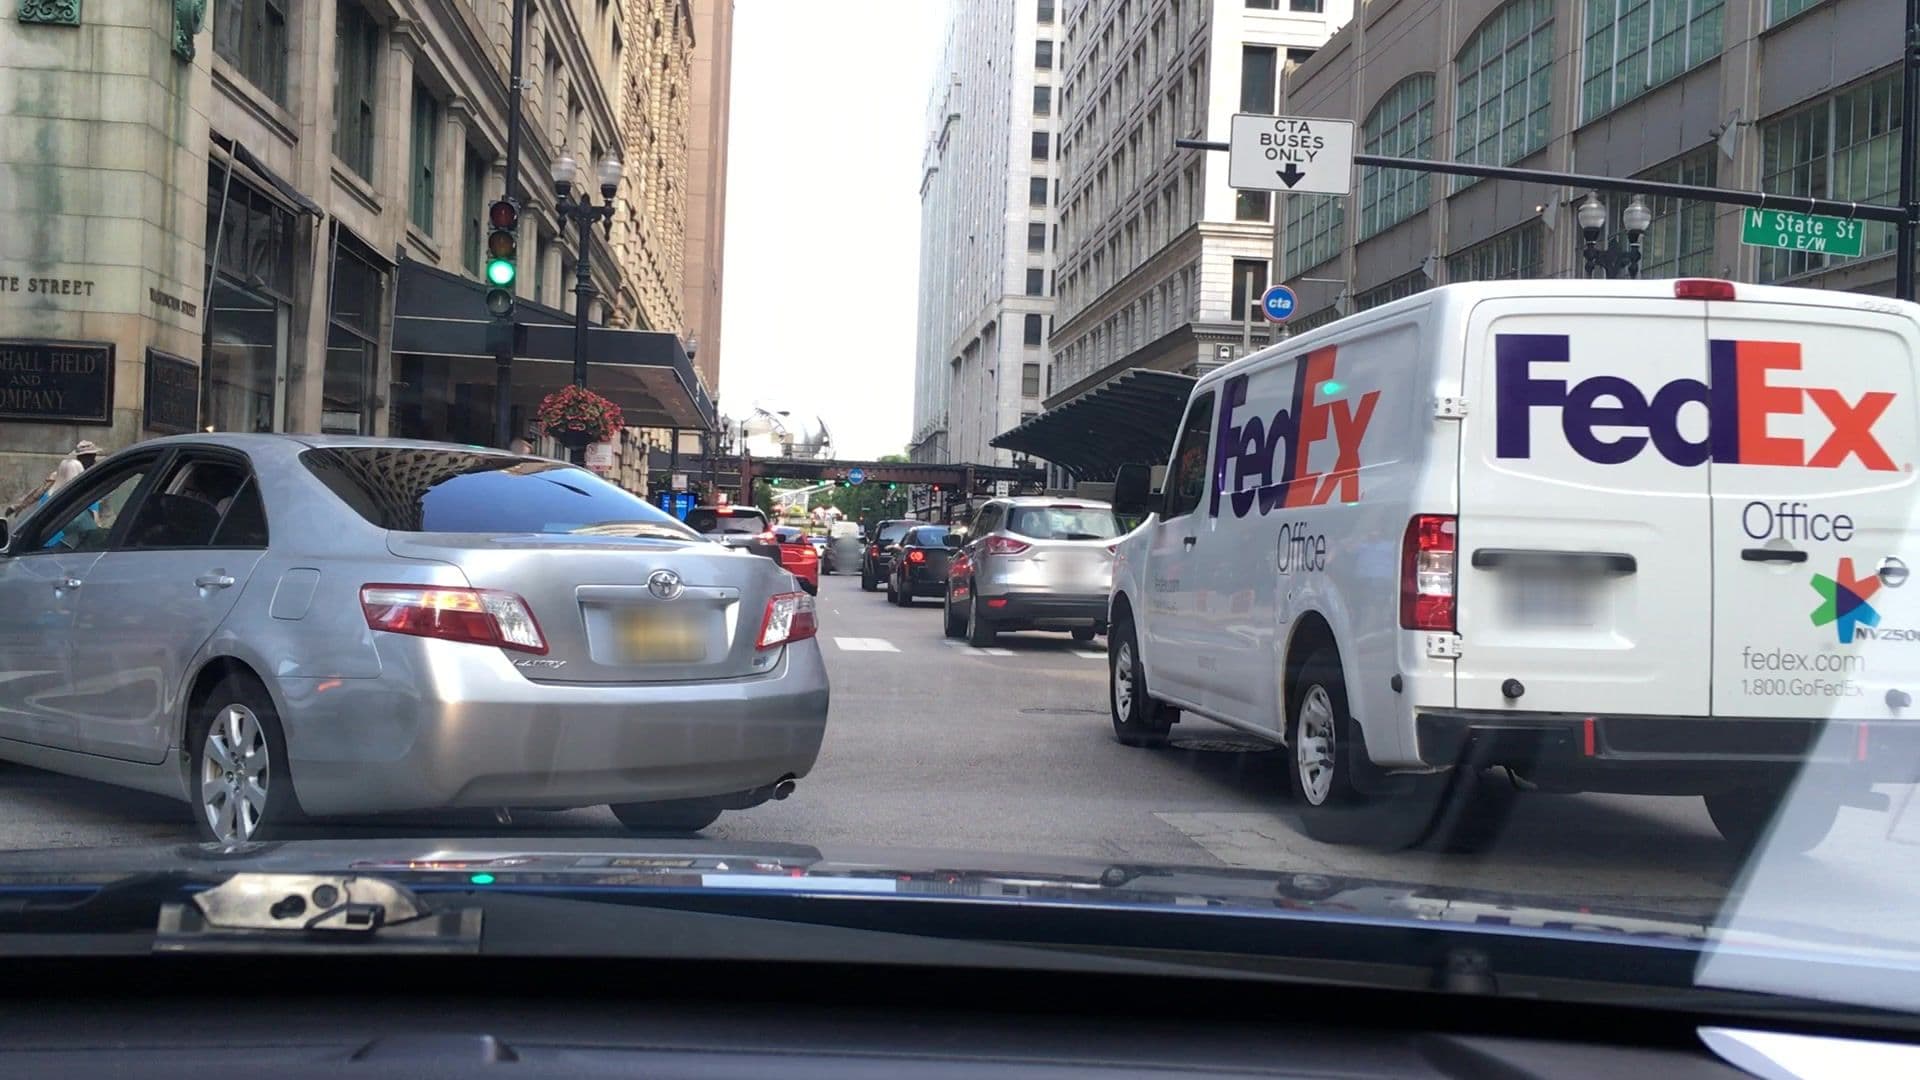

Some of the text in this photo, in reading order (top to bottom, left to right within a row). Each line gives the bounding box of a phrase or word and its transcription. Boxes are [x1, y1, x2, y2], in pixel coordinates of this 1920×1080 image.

[1275, 120, 1311, 134] CTA
[1260, 133, 1324, 149] BUSES
[1265, 147, 1318, 163] ONLY
[1752, 210, 1855, 239] N State St
[1796, 235, 1826, 251] E/W
[28, 278, 95, 296] STREET
[1268, 297, 1292, 310] cta
[0, 351, 96, 374] HALL FIELD
[10, 374, 41, 385] AND
[1495, 333, 1901, 472] FedEx
[1209, 343, 1381, 518] FedEx
[1742, 501, 1854, 541] Office
[1277, 521, 1326, 572] Office
[1742, 646, 1865, 672] fedex.com
[1742, 678, 1864, 697] 1.800.GoFedEx
